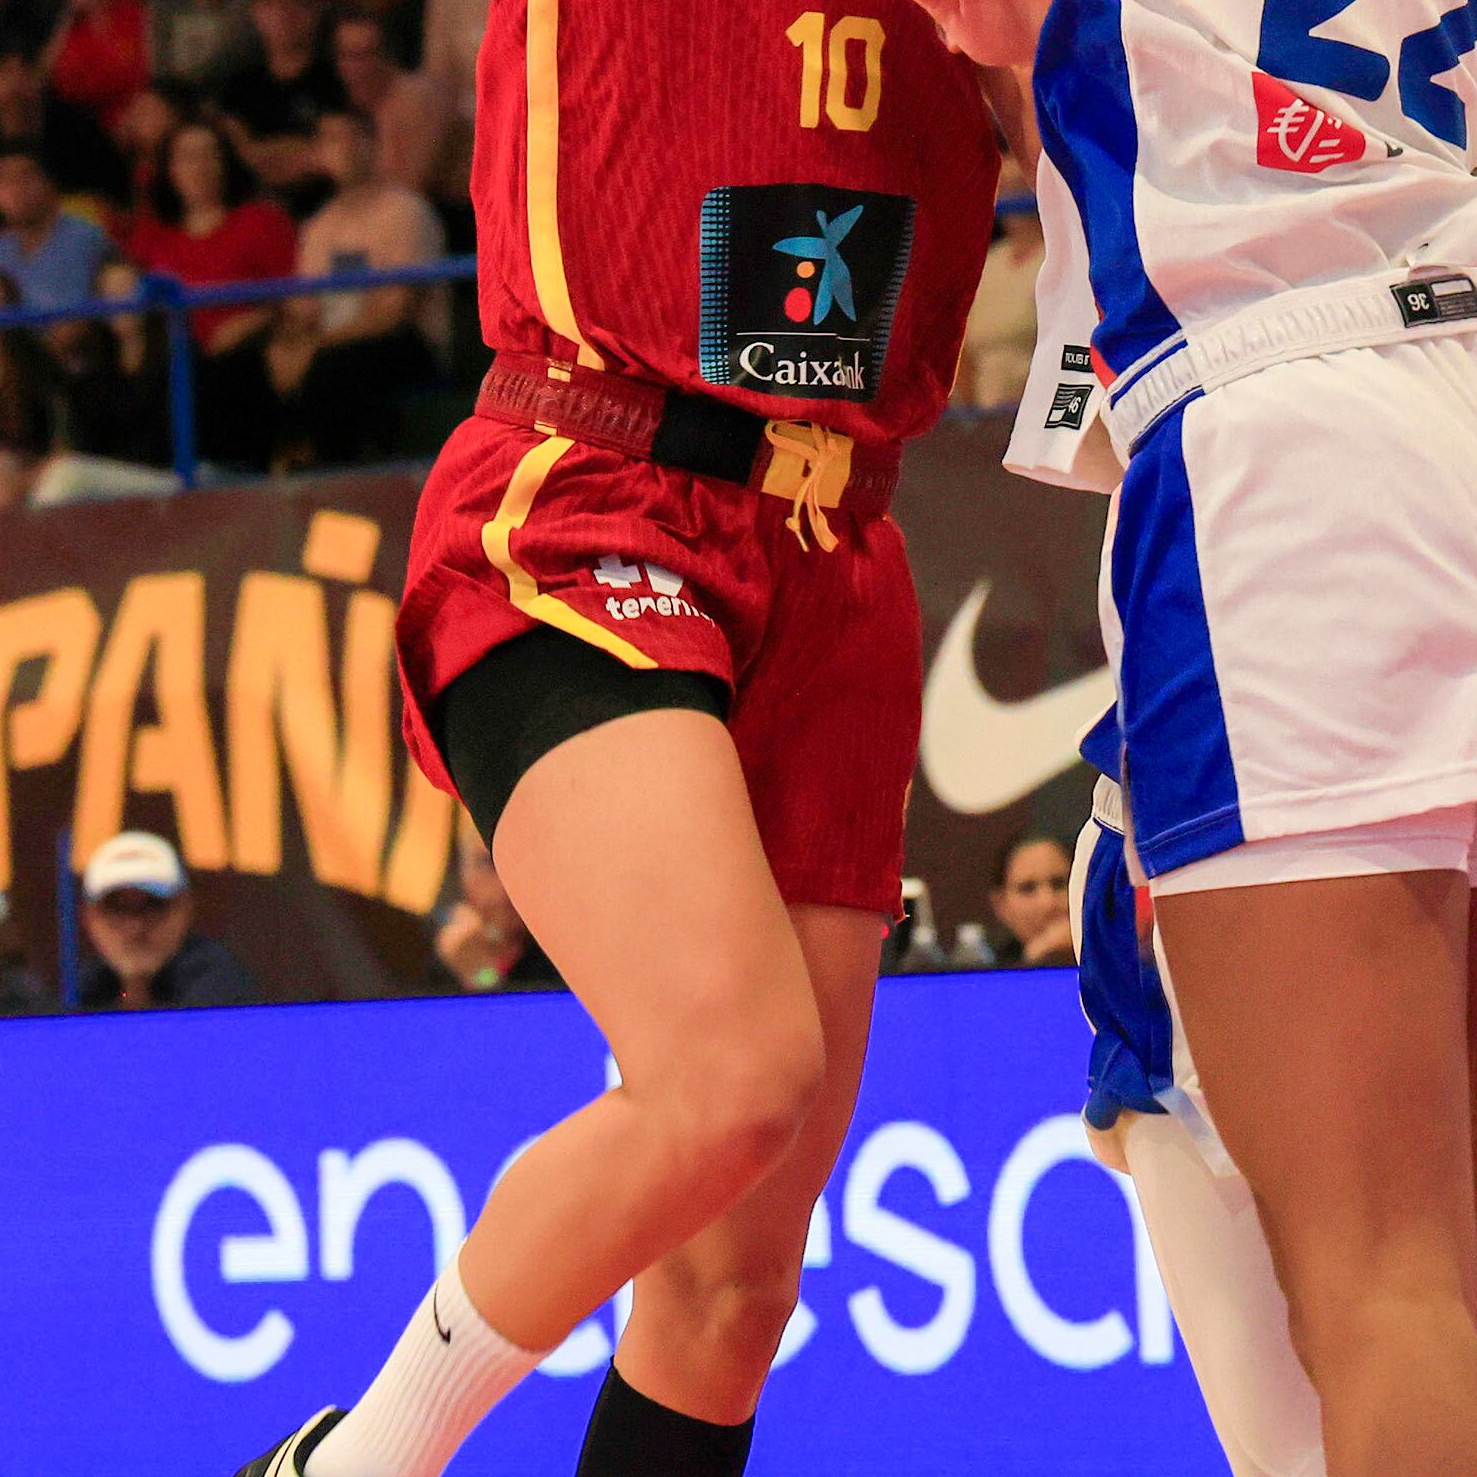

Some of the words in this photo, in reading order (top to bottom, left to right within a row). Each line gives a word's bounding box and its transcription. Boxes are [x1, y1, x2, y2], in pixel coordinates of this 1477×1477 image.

[785, 11, 887, 132] 10
[739, 341, 865, 390] Caixank
[151, 1051, 1174, 1384] ensa
